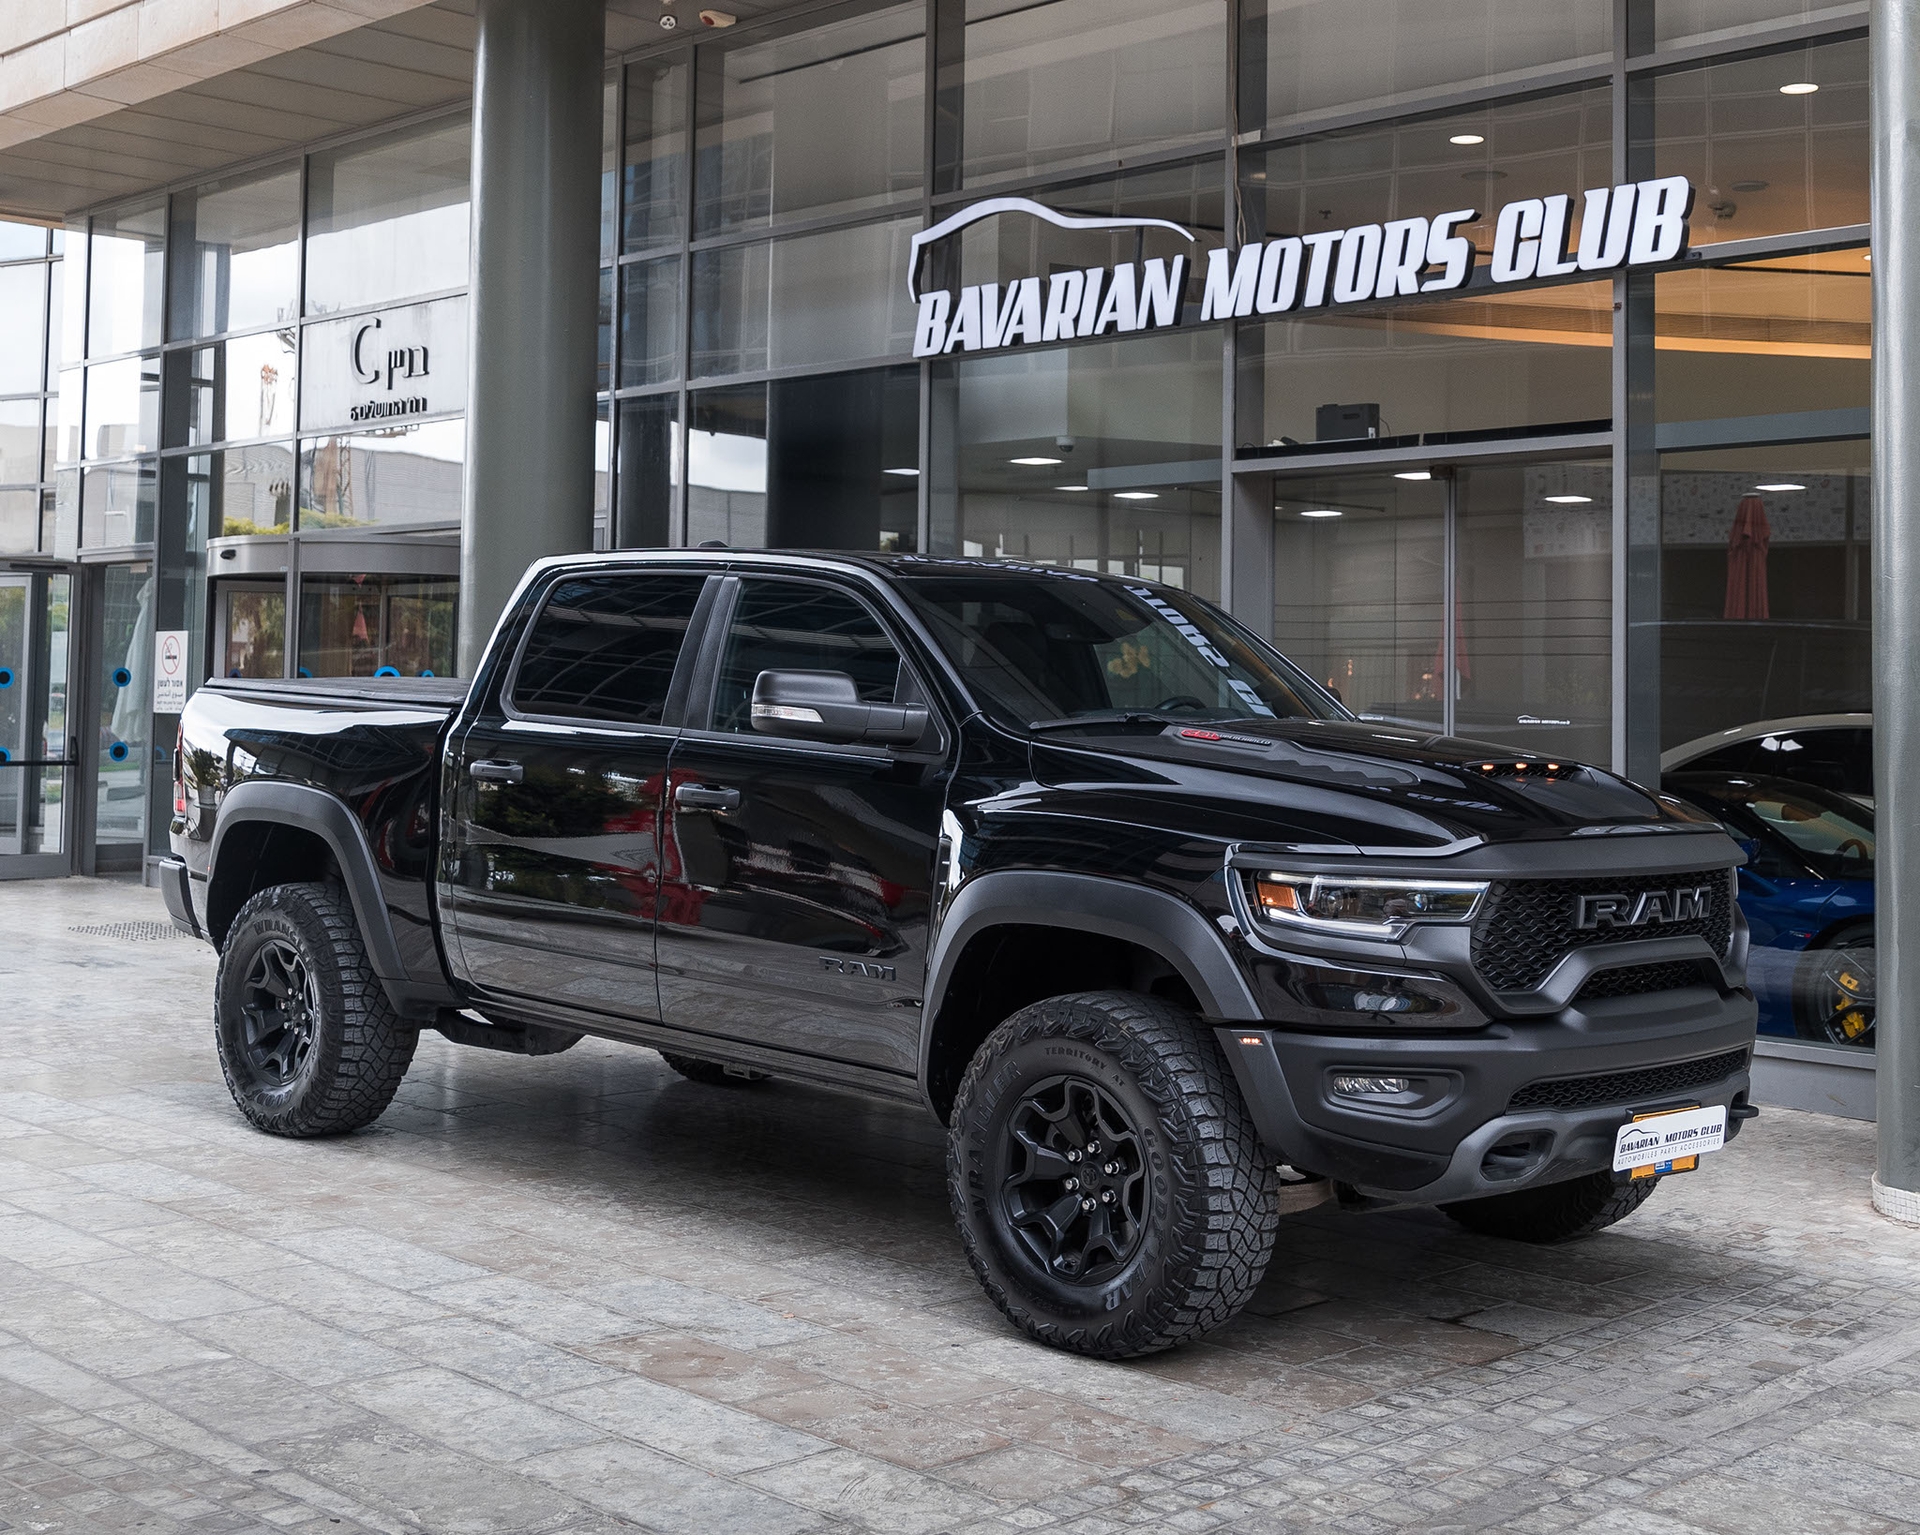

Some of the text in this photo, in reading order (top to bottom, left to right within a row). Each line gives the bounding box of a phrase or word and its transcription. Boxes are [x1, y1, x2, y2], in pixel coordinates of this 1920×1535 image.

[912, 175, 1696, 358] BAVARIAN MOTORS CLUB
[350, 317, 382, 385] C
[1577, 886, 1712, 929] RAM
[819, 956, 896, 981] RAM
[1044, 1047, 1125, 1087] TERRITORY AT
[969, 1061, 1022, 1219] WRANGLER
[1617, 1151, 1657, 1165] AUTOMOBILES
[1660, 1147, 1677, 1156] PARTS
[1680, 1138, 1720, 1151] ACCESSORIES
[1620, 1124, 1722, 1153] BAVARIAN MOTORS CLUB
